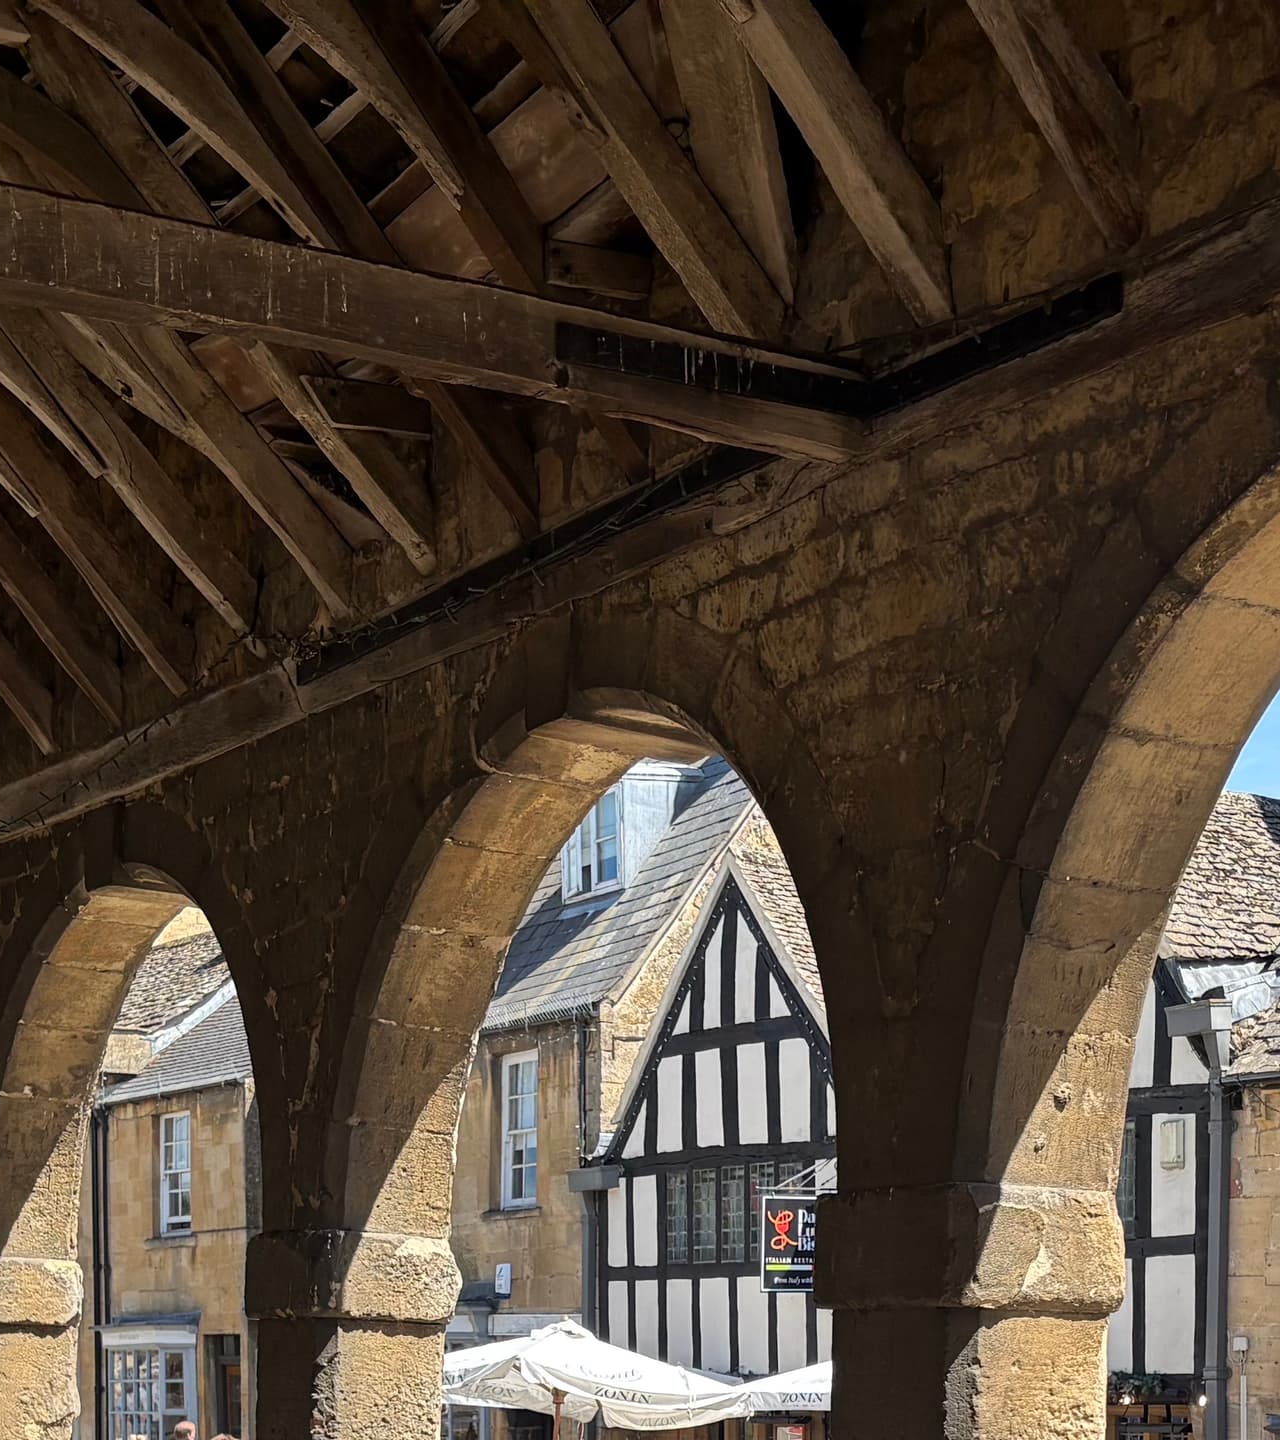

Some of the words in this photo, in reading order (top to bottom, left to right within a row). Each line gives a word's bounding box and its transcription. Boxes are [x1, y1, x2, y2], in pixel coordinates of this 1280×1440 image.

[797, 1209, 816, 1224] Da
[797, 1224, 816, 1236] Lu
[765, 1256, 791, 1264] ITALIAN
[793, 1256, 815, 1264] RESTA
[594, 1385, 652, 1404] ZONIN
[781, 1392, 824, 1404] ZONIN
